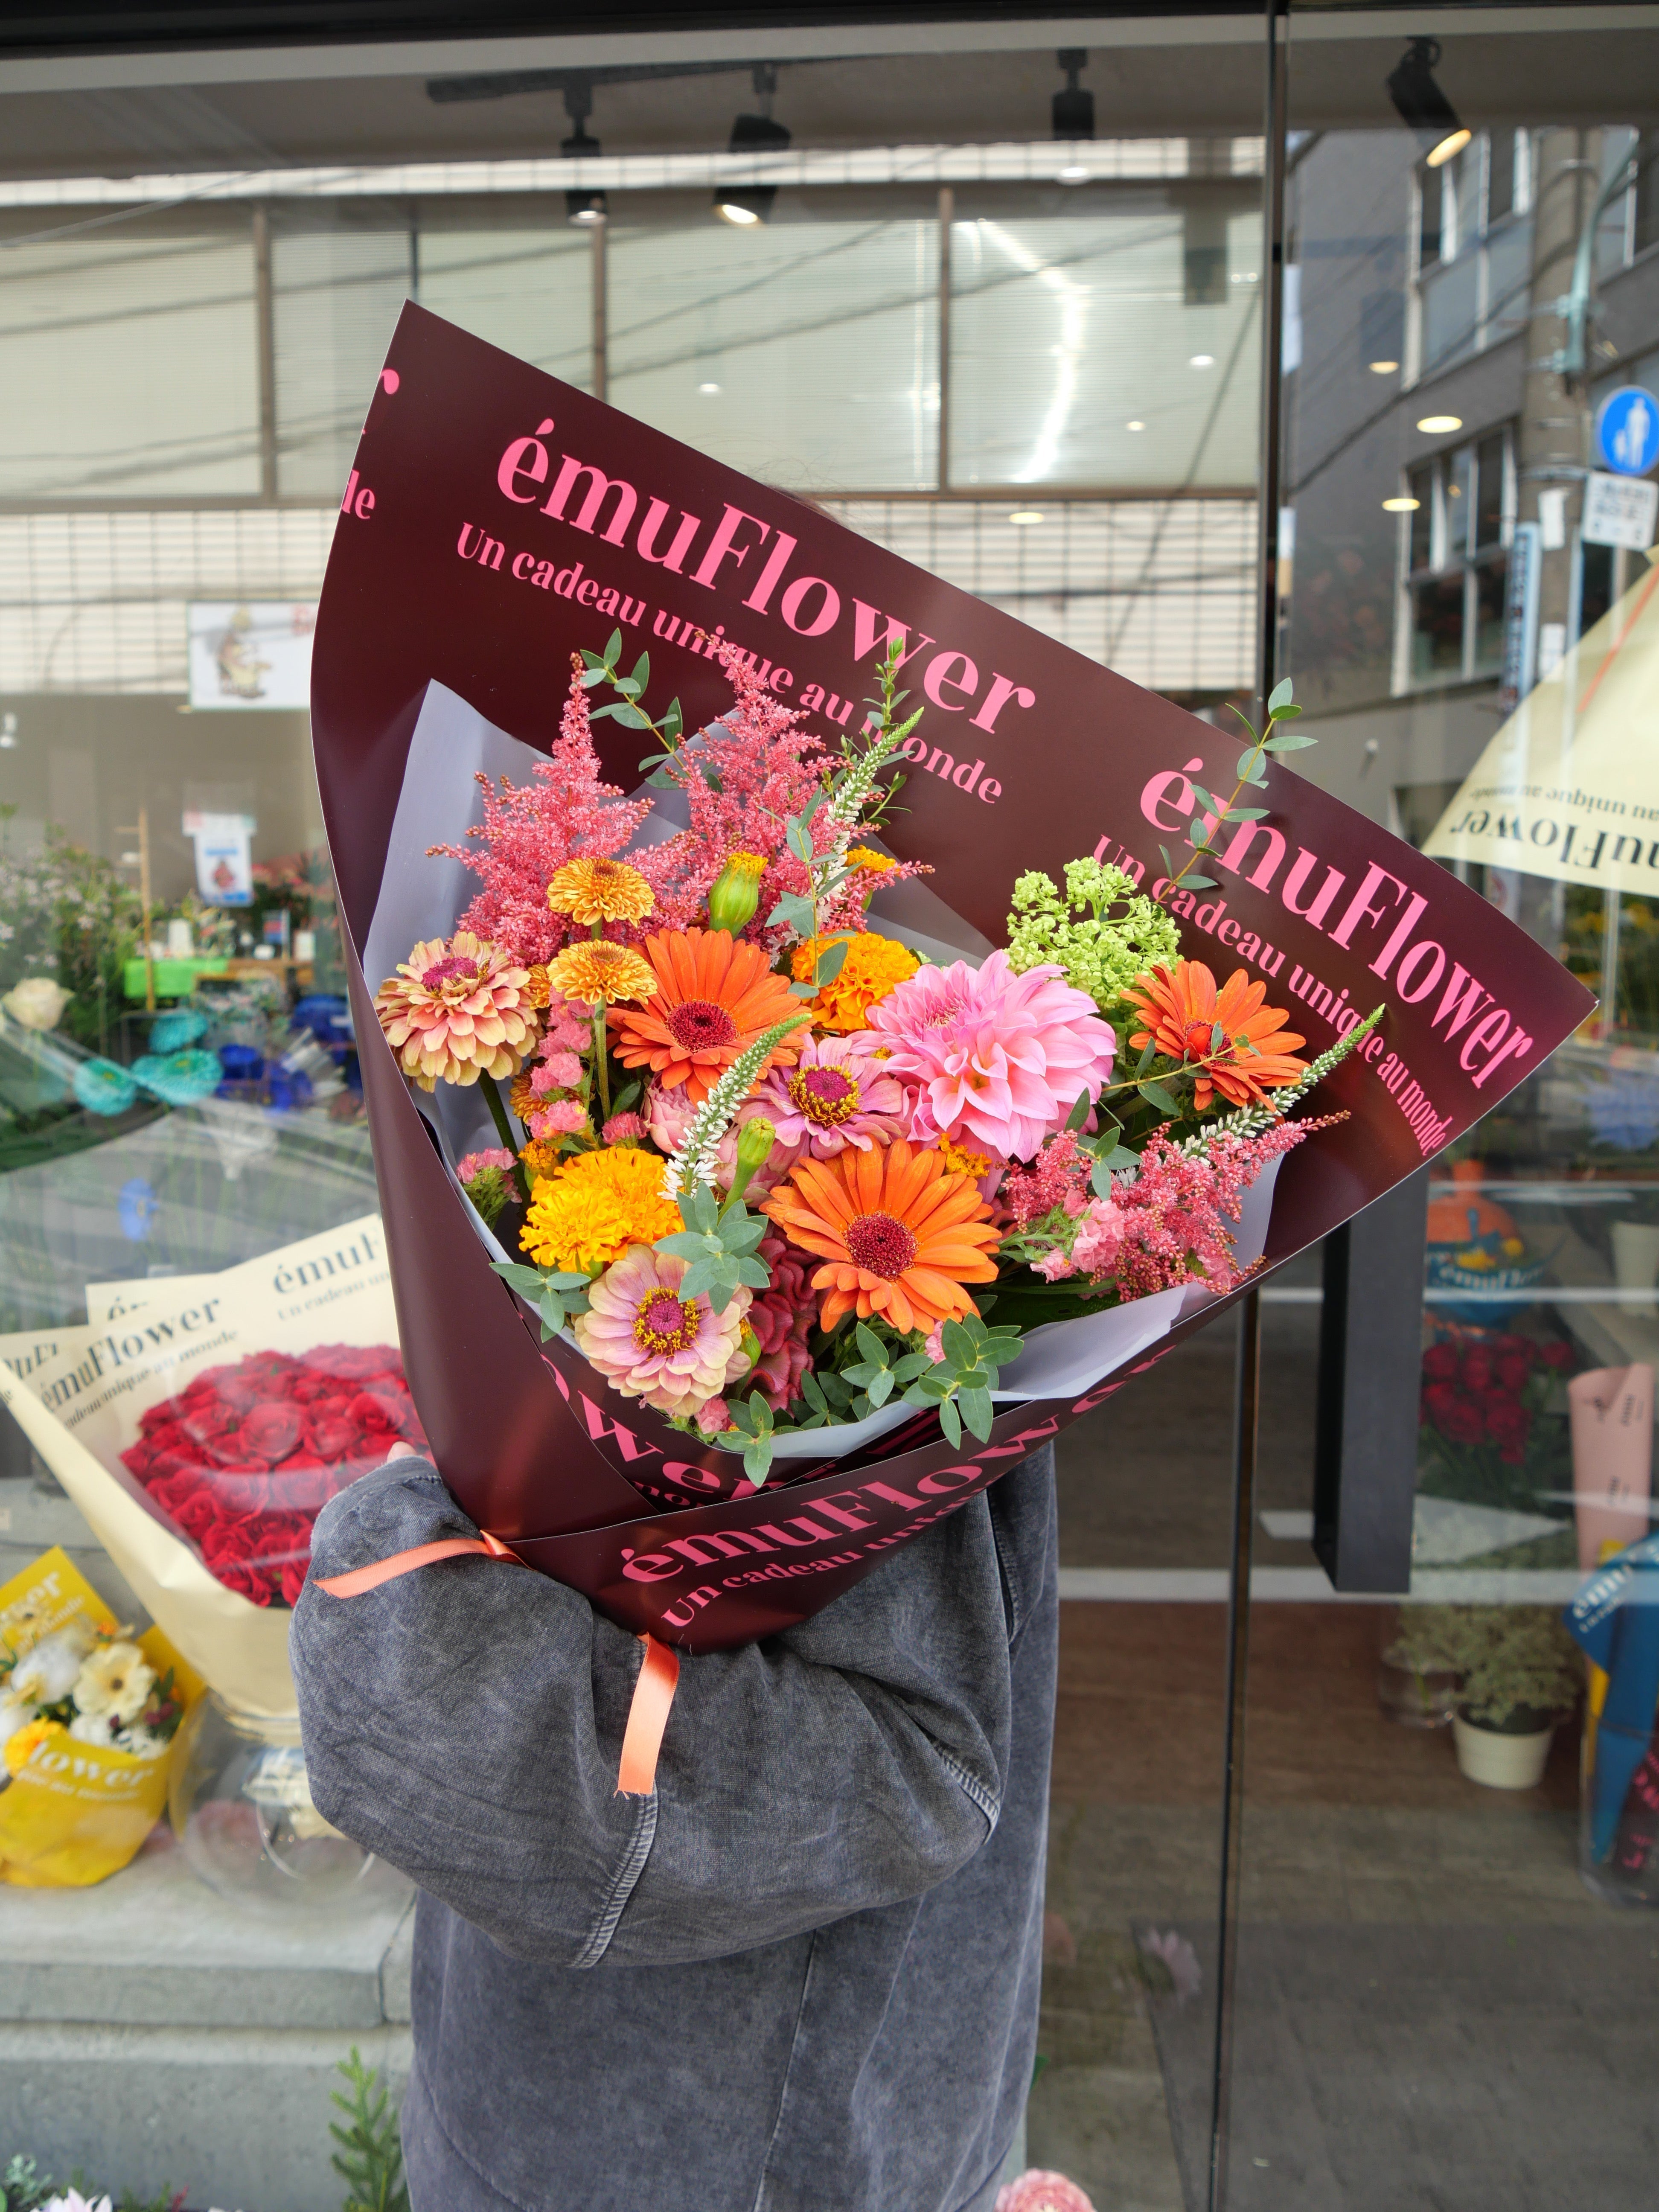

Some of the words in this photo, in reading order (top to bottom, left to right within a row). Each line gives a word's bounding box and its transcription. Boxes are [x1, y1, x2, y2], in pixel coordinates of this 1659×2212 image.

[457, 522, 505, 571] Un
[512, 552, 647, 626] cadeau
[799, 684, 854, 726] au
[498, 418, 1036, 734] émuFlower
[1093, 834, 1146, 889] Un
[1152, 877, 1286, 978] cadeau
[1377, 1053, 1410, 1094] au
[1397, 1079, 1453, 1156] monde
[1140, 757, 1534, 1089] émuFlower
[621, 1344, 1177, 1583] émuFlower
[661, 1583, 723, 1627] Un
[722, 1550, 866, 1588] cadeau
